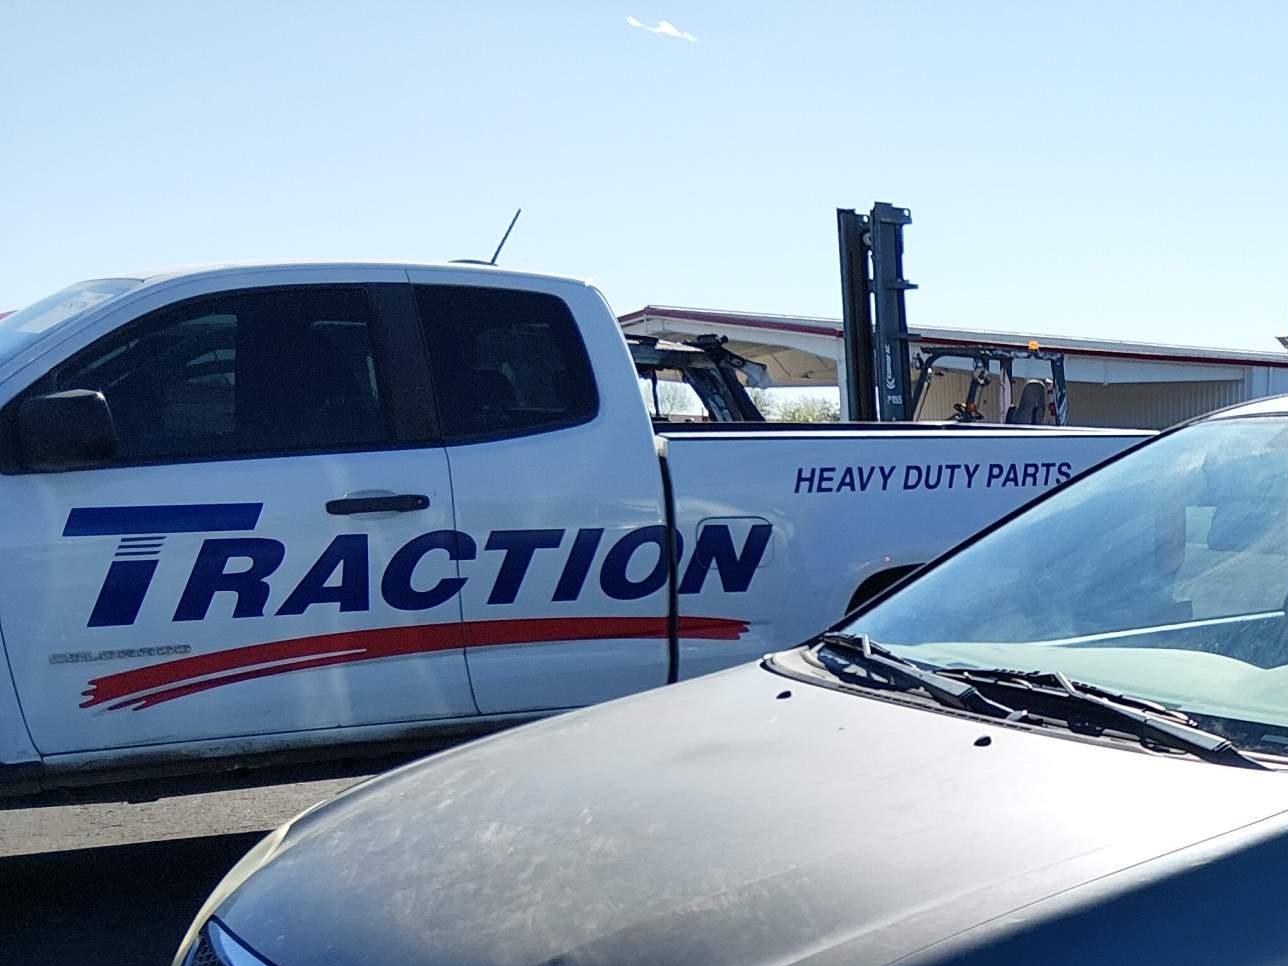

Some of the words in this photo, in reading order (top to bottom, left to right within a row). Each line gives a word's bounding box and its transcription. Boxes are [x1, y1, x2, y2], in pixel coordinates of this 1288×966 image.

[794, 465, 896, 494] HEAVY
[903, 463, 980, 490] DUTY
[986, 461, 1072, 488] PARTS
[62, 502, 773, 628] TRACTION
